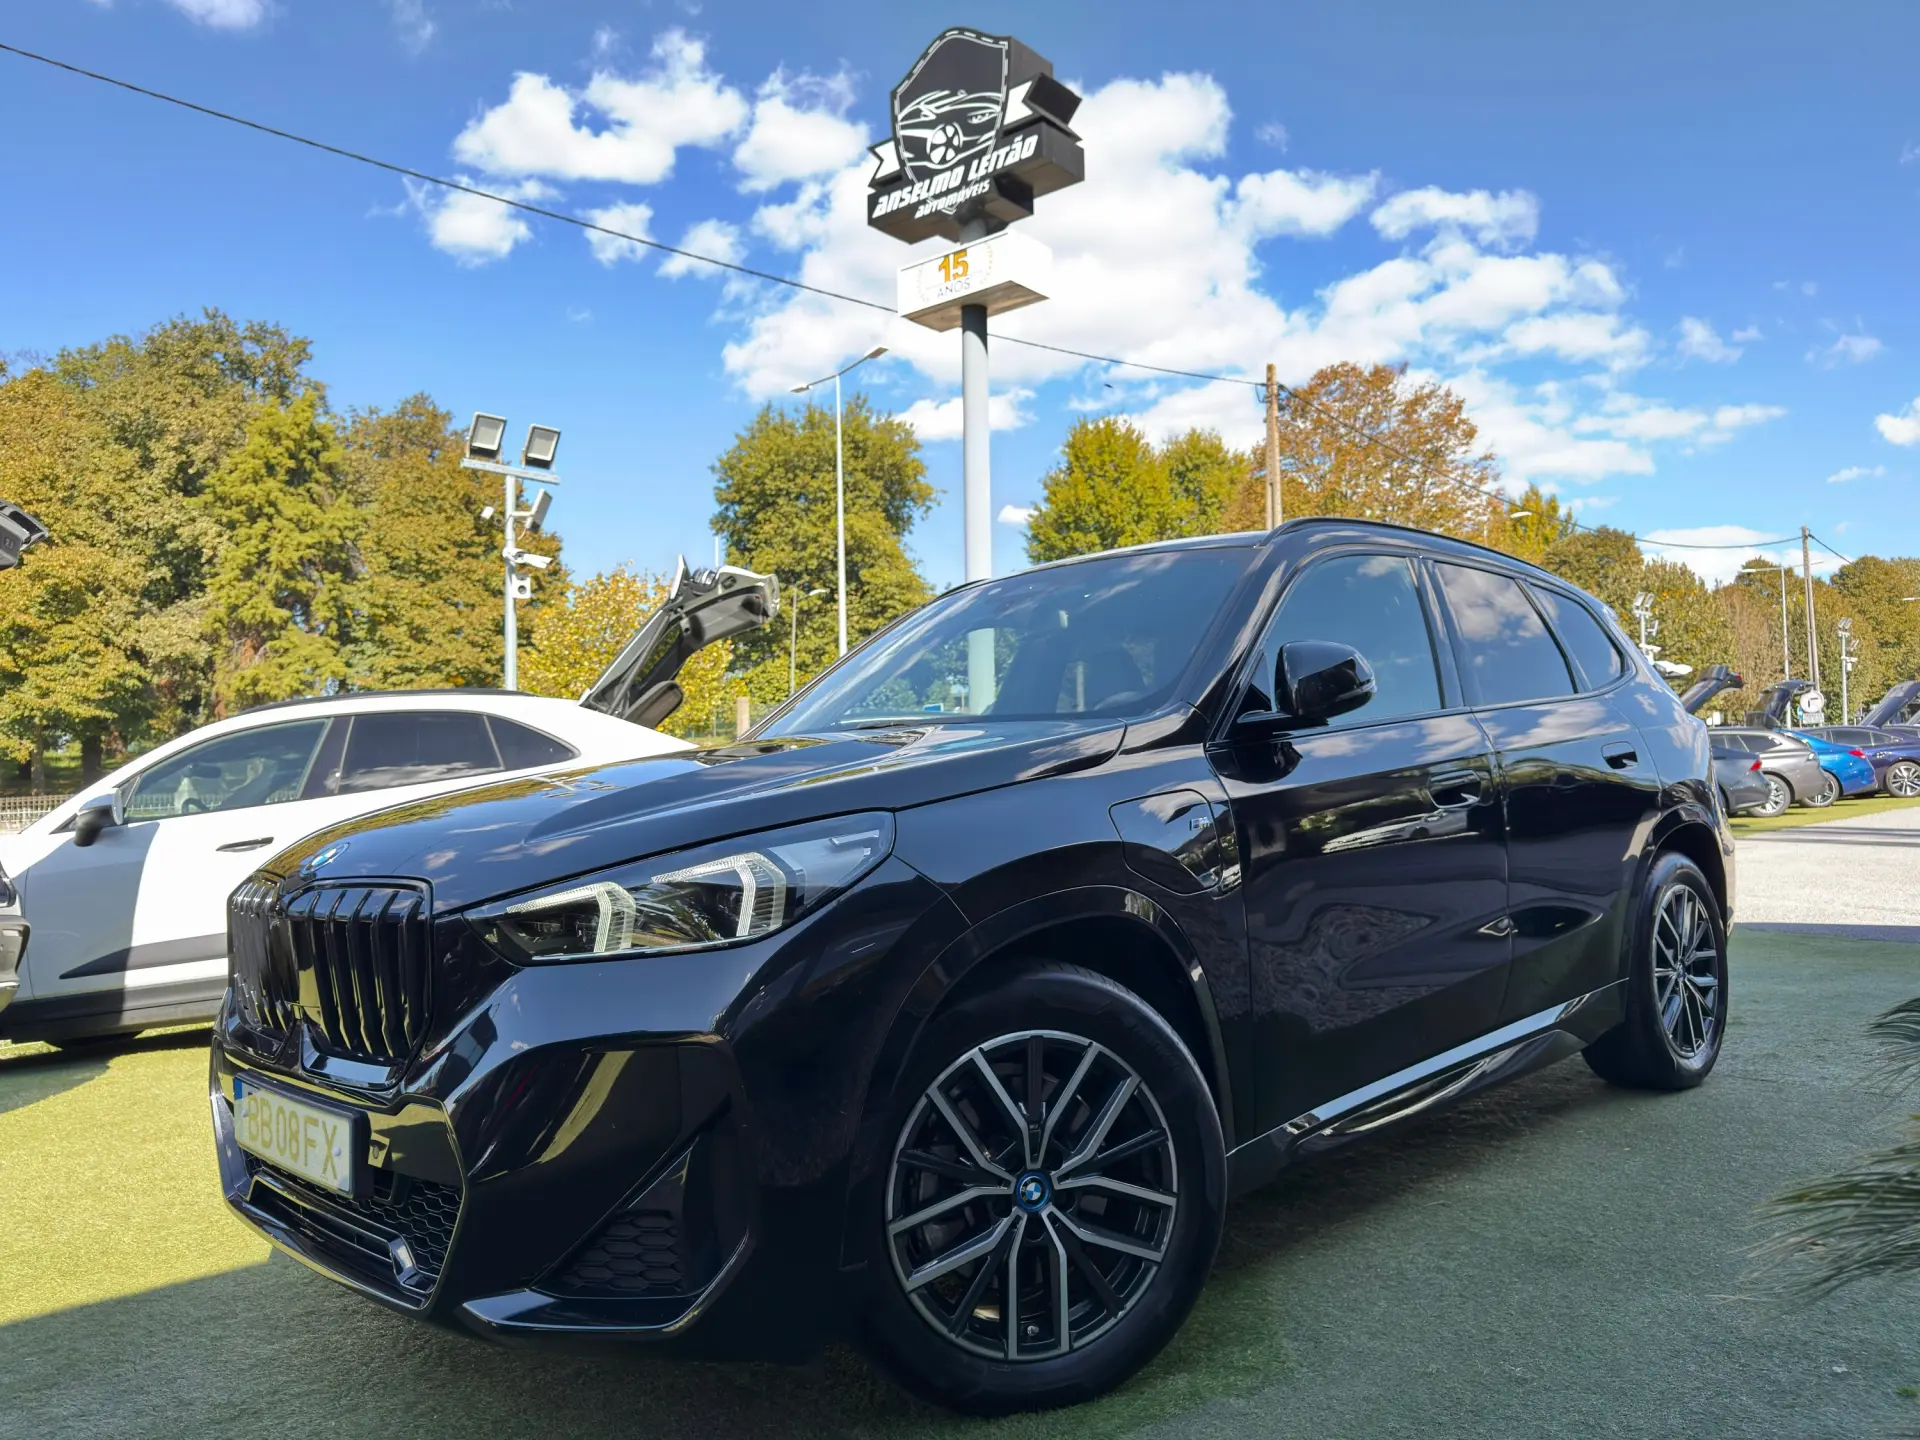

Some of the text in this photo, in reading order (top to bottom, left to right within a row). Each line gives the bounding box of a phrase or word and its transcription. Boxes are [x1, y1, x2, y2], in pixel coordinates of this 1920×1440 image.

[967, 135, 1038, 180] LEITÃO
[938, 249, 969, 283] 15
[937, 277, 970, 299] ANOS
